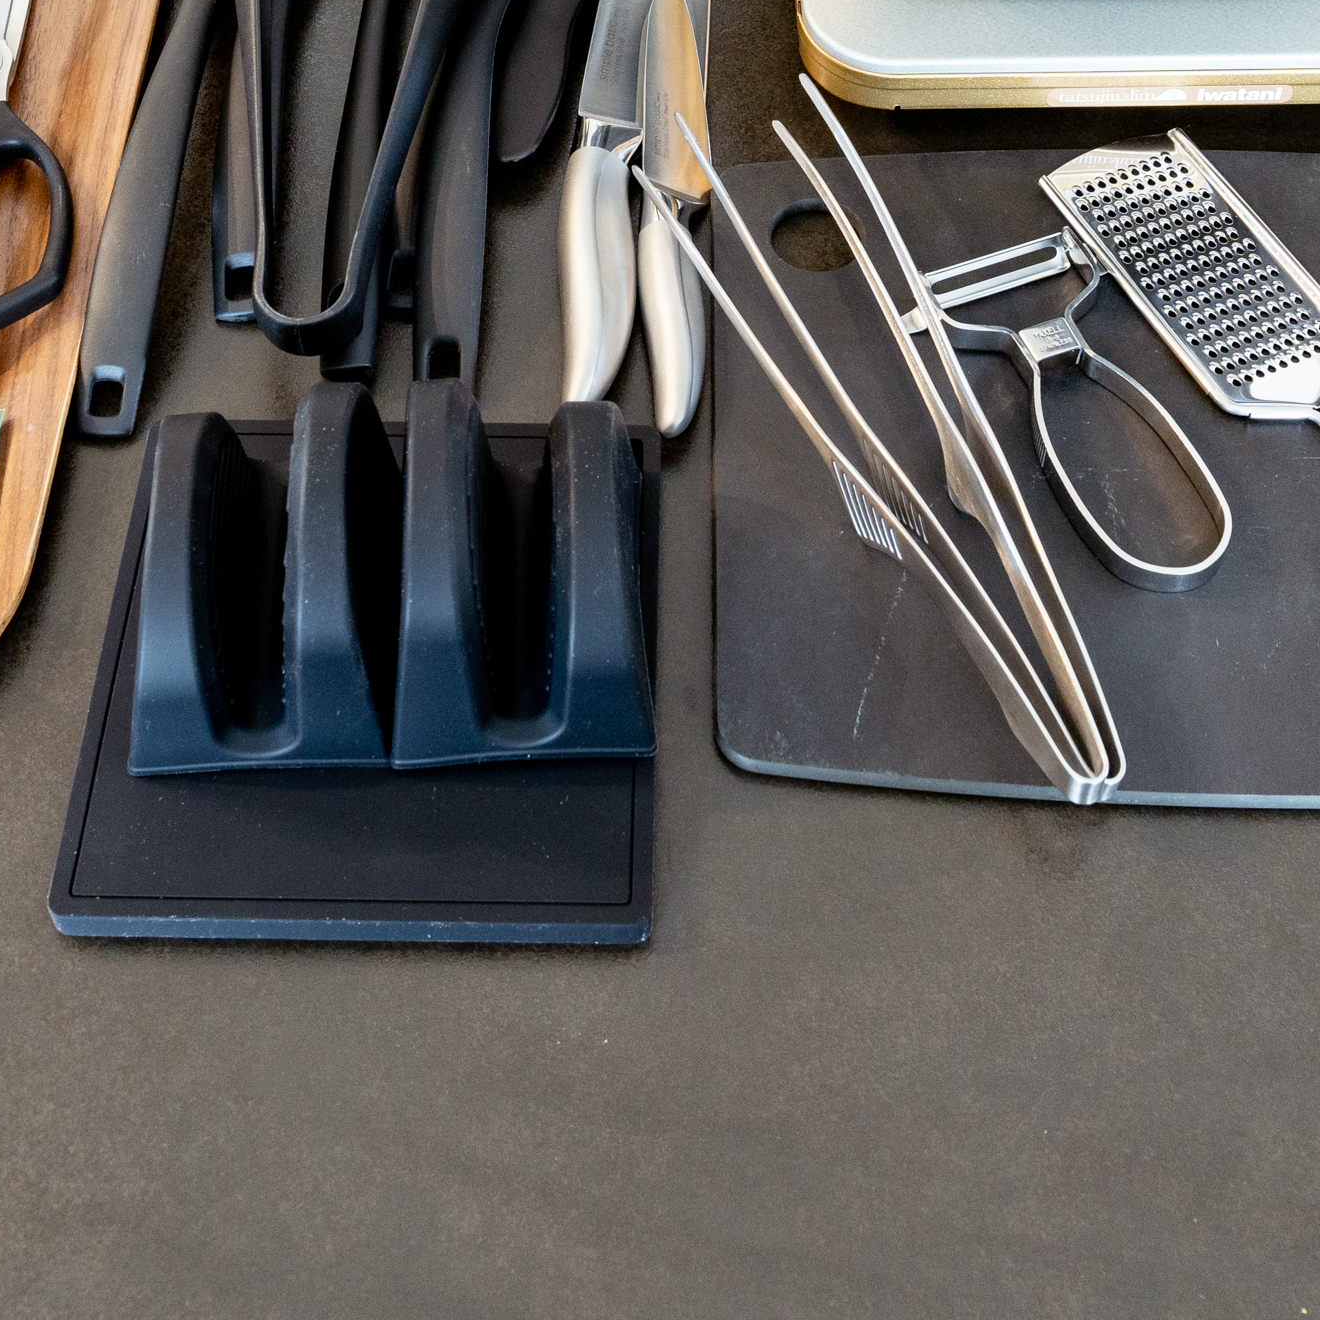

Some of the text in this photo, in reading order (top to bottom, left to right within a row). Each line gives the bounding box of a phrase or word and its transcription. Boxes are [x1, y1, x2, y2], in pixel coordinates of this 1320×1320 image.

[600, 20, 616, 80] simple basic
[1059, 87, 1282, 104] tatsujin slim Iwatani
